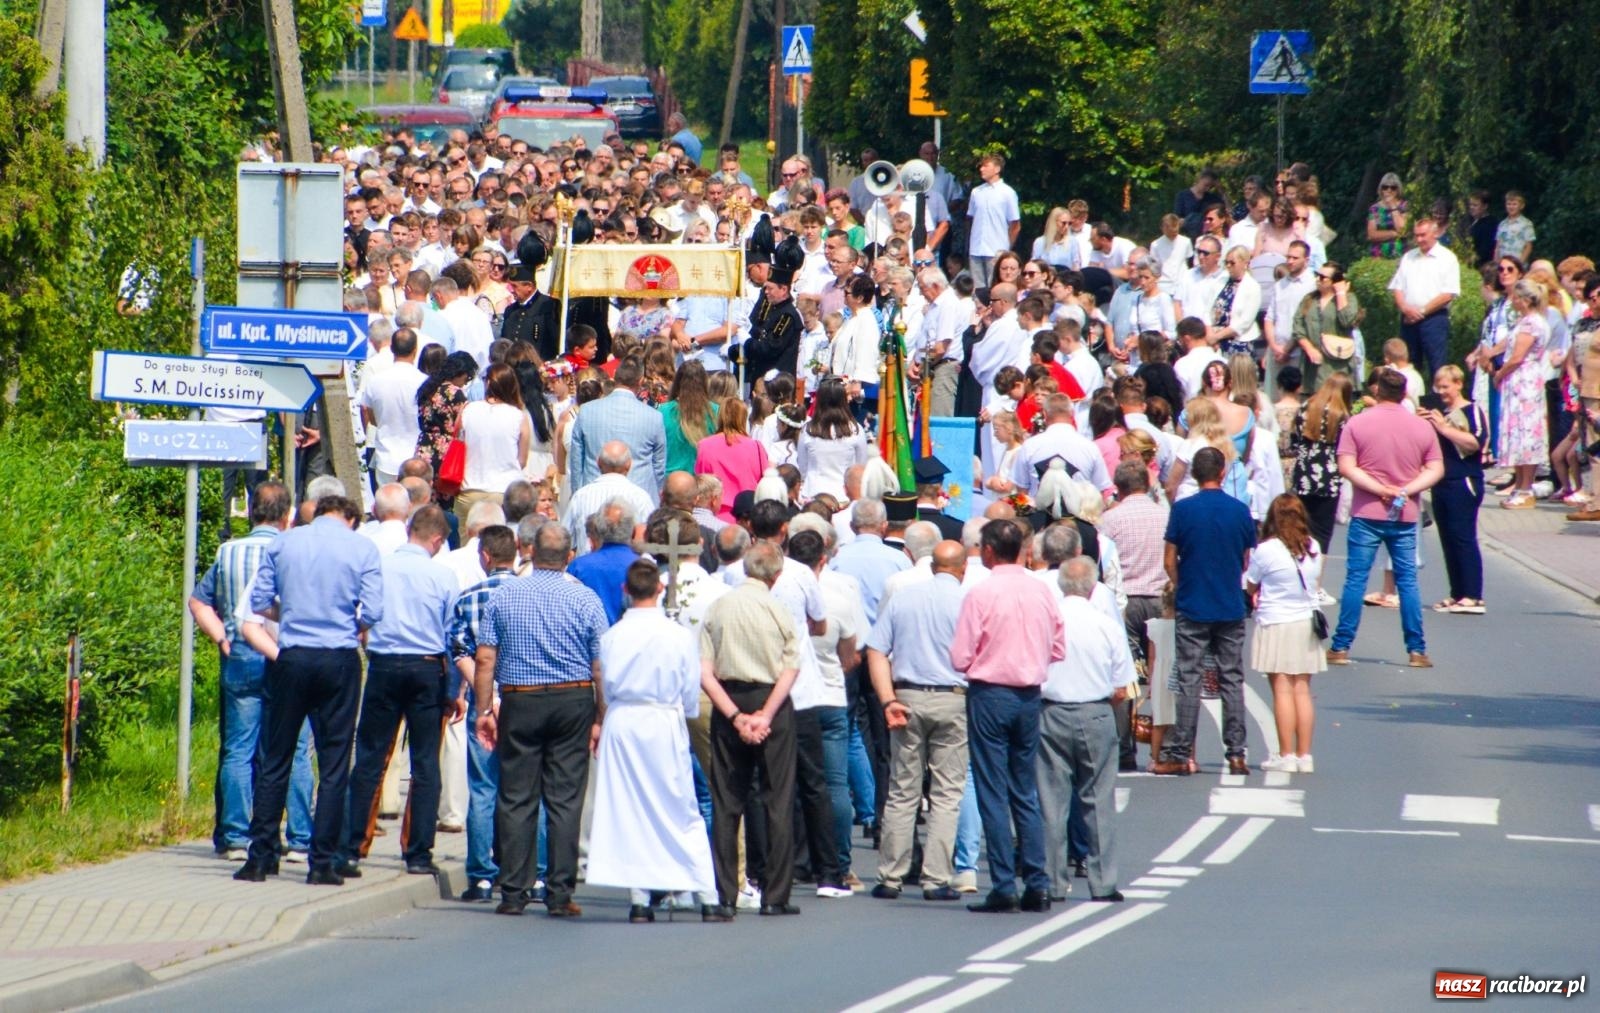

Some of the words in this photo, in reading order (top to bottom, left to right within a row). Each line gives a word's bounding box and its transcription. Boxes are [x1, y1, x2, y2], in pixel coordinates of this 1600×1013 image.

[217, 322, 236, 339] ul.
[241, 323, 270, 344] Kpt.
[275, 323, 348, 345] Myśliwca
[144, 359, 158, 370] Do
[164, 361, 195, 374] grobu
[202, 363, 228, 376] Sługi
[235, 365, 263, 379] Bożej
[176, 380, 265, 405] Dulcissimy
